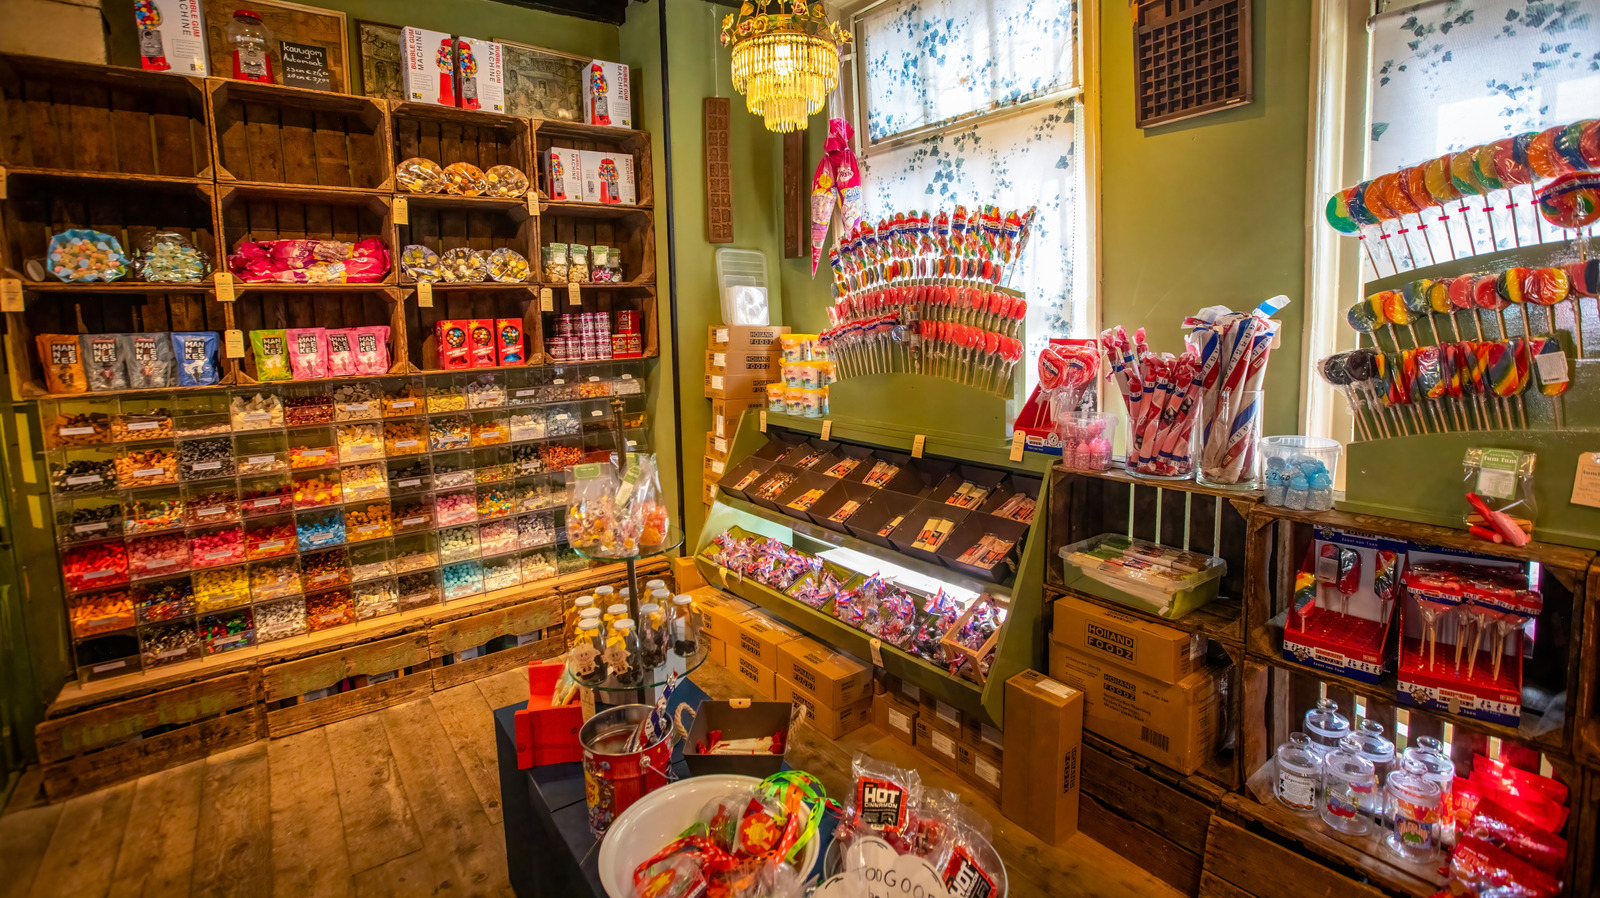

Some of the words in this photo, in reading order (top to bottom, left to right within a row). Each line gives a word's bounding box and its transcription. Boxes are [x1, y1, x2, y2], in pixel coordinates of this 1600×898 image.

[179, 0, 191, 36] CHINE
[189, 0, 199, 19] BBLE
[191, 20, 201, 38] GUM
[408, 28, 416, 44] GUM
[409, 44, 417, 70] BUBBLE
[415, 30, 424, 71] MACHINE
[488, 43, 496, 83] MACHINE
[1088, 623, 1134, 648] HOllAND
[1088, 635, 1133, 661] FOODZ
[864, 787, 900, 803] HOT
[949, 859, 974, 897] HOT
